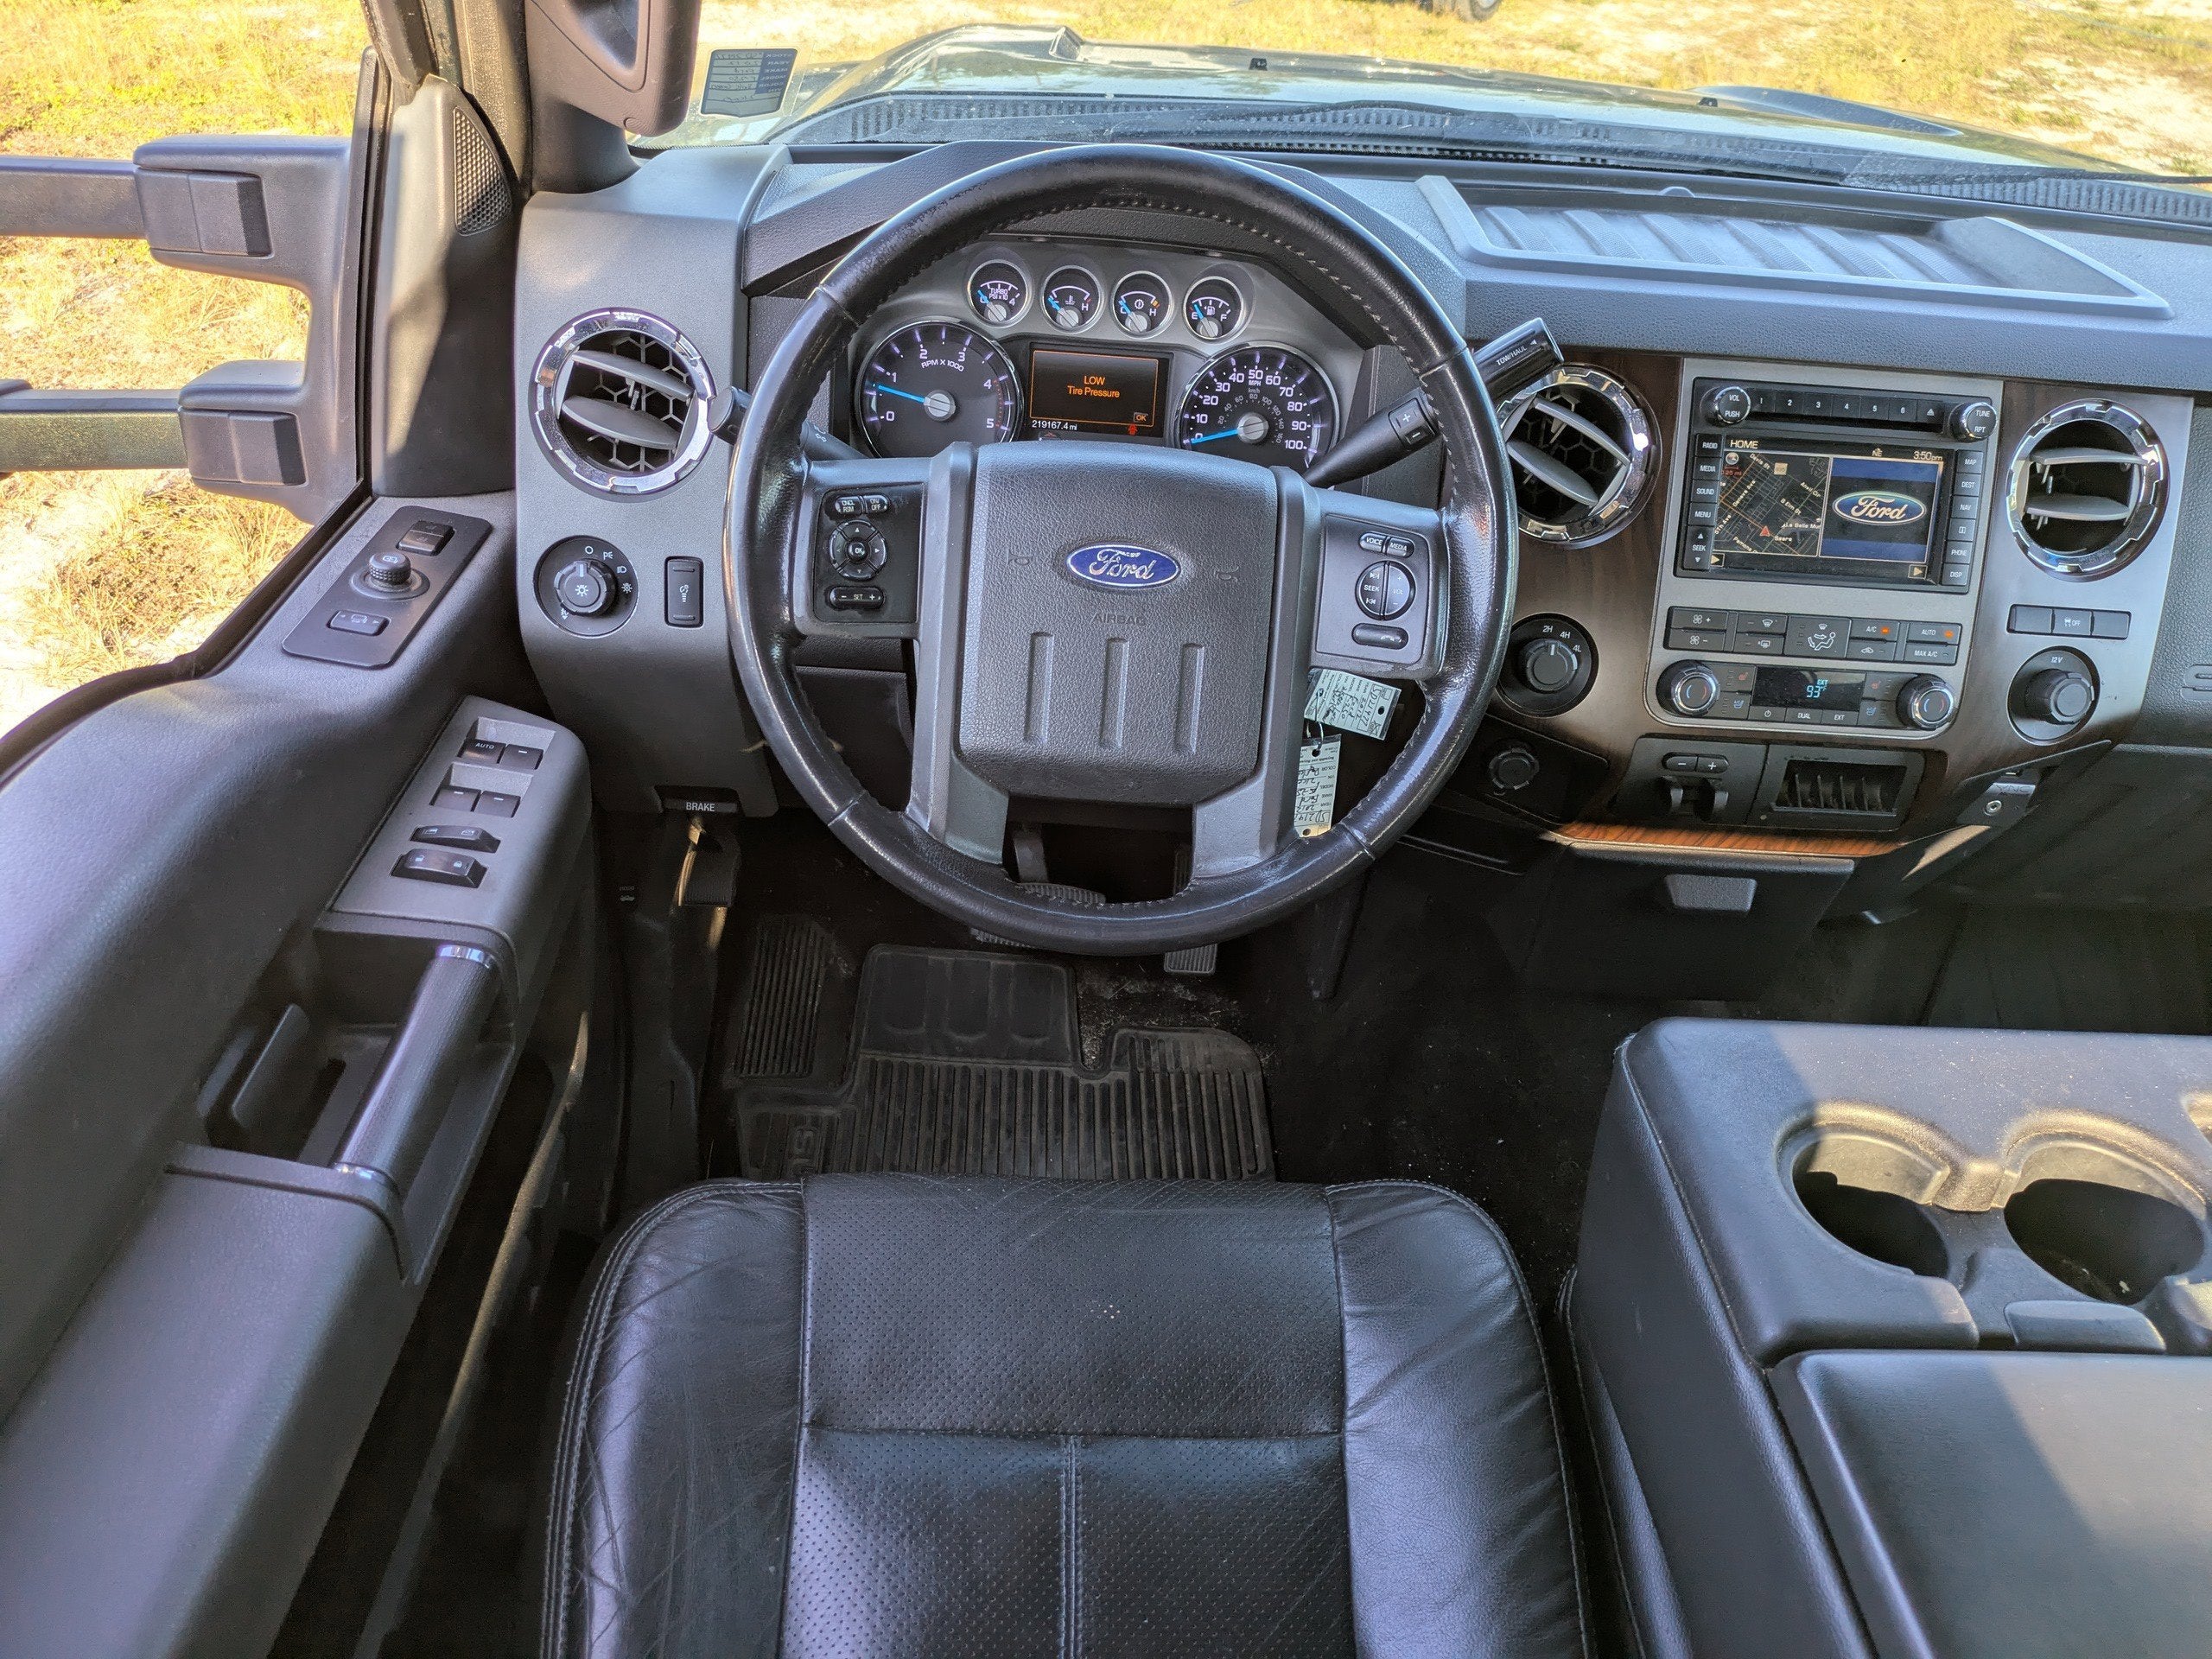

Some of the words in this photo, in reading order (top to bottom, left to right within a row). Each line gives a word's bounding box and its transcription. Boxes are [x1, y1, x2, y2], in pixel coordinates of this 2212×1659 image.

[919, 349, 928, 359] 2
[958, 352, 965, 362] 3
[1496, 346, 1527, 365] TOW/HAUL
[921, 359, 939, 369] RPM
[947, 360, 964, 372] 1000
[892, 372, 897, 382] 1
[1229, 373, 1244, 383] 40
[1249, 369, 1263, 380] 50
[983, 379, 992, 389] 4
[1084, 376, 1106, 385] LOW
[1265, 375, 1281, 385] 60
[1068, 385, 1082, 395] Tire
[1084, 387, 1120, 398] Pressure
[1215, 382, 1230, 392] 30
[1279, 387, 1294, 397] 70
[1203, 395, 1219, 405] 20
[1287, 402, 1302, 412] 80
[886, 411, 895, 421] 0
[1195, 414, 1208, 424] 10
[1976, 410, 1991, 418] TUNE
[987, 419, 994, 428] 5
[1032, 420, 1068, 430] 219167.4
[1291, 421, 1307, 431] 90
[1974, 425, 1986, 433] RPT
[1285, 440, 1303, 450] 100
[1730, 439, 1758, 449] HOME
[1913, 451, 1943, 461] 3:50pm
[1851, 496, 1908, 520] Ford
[1366, 537, 1382, 546] VOICE
[1390, 542, 1407, 551] MEDIA
[1089, 548, 1157, 580] Ford
[1091, 613, 1147, 626] AIRBAG
[1560, 631, 1570, 639] 4H
[1573, 644, 1582, 652] 4L
[686, 802, 715, 811] BRAKE
